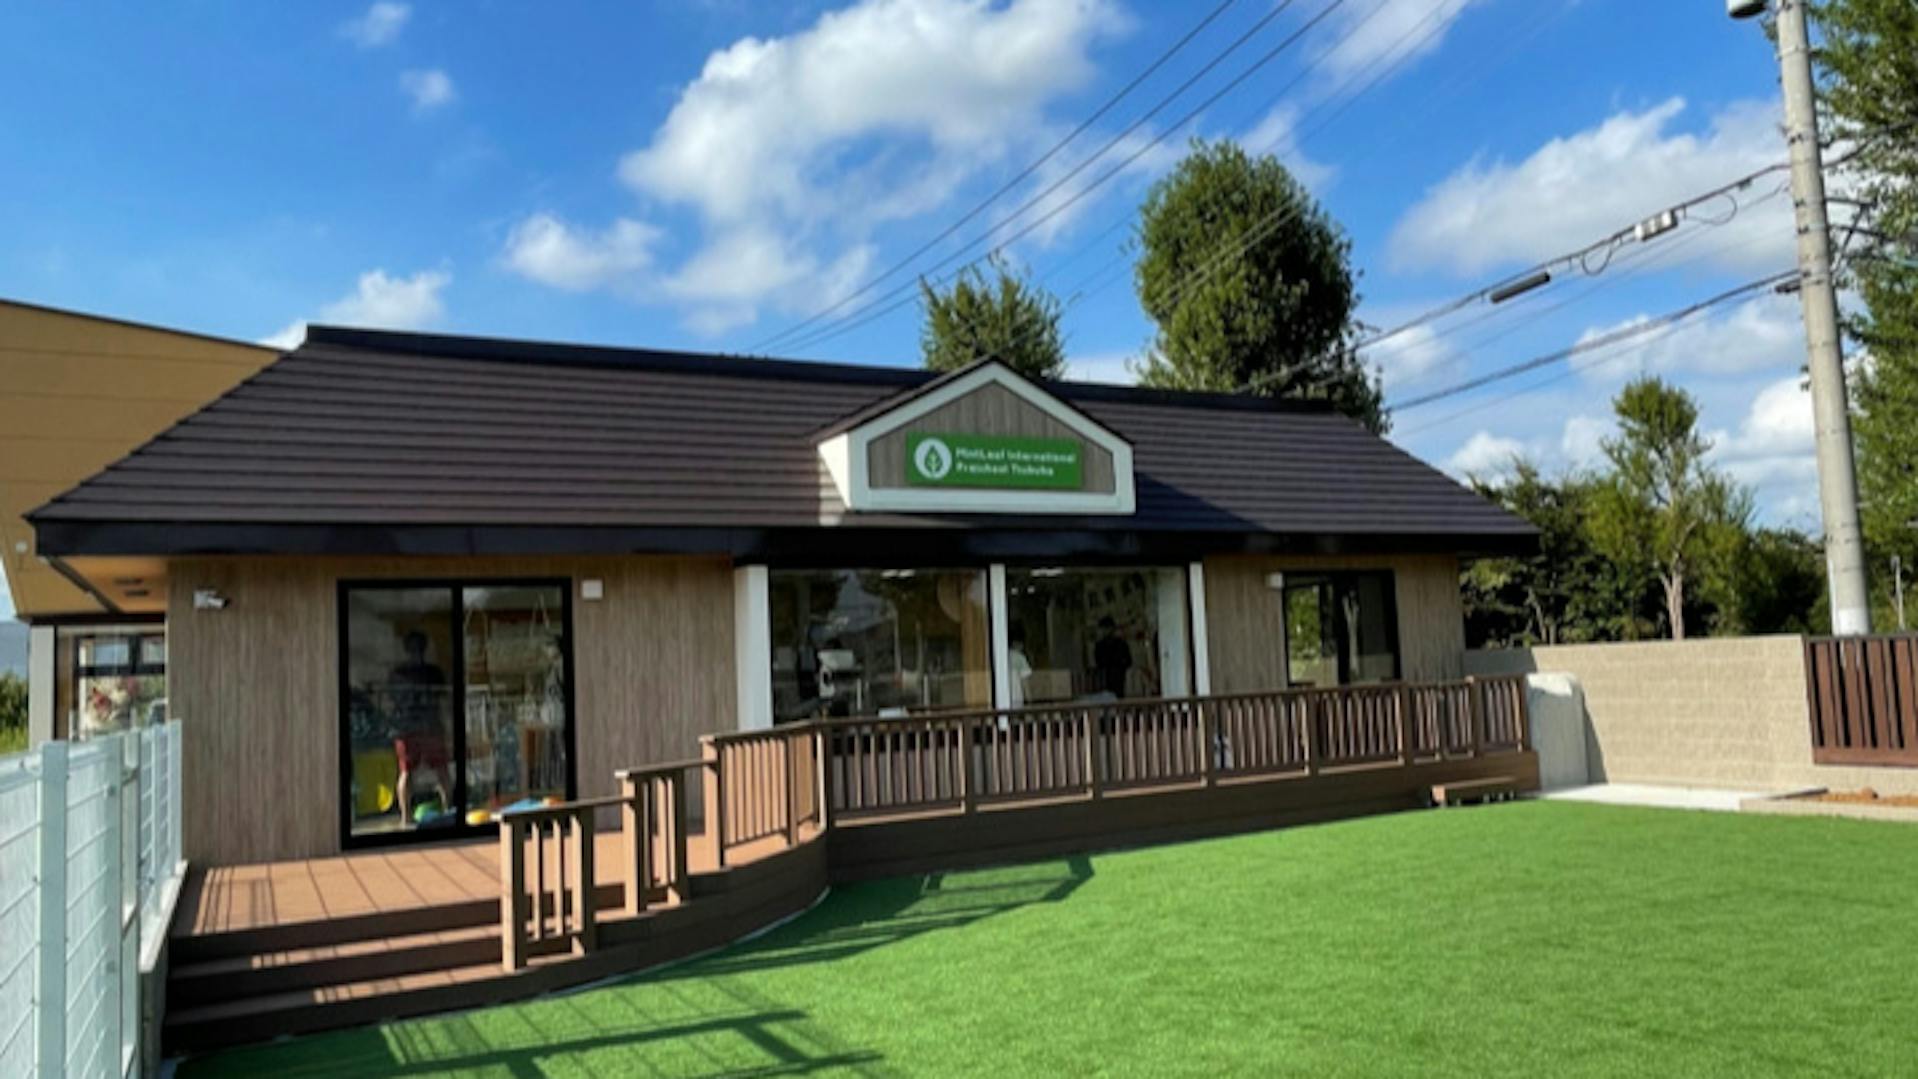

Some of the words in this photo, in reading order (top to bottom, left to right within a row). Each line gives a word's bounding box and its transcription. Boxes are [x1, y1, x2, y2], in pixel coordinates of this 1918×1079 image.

[956, 447, 1005, 461] MintLeaf
[1008, 449, 1075, 463] International
[956, 461, 1008, 474] Preschool
[1011, 462, 1054, 476] Tsukuba
